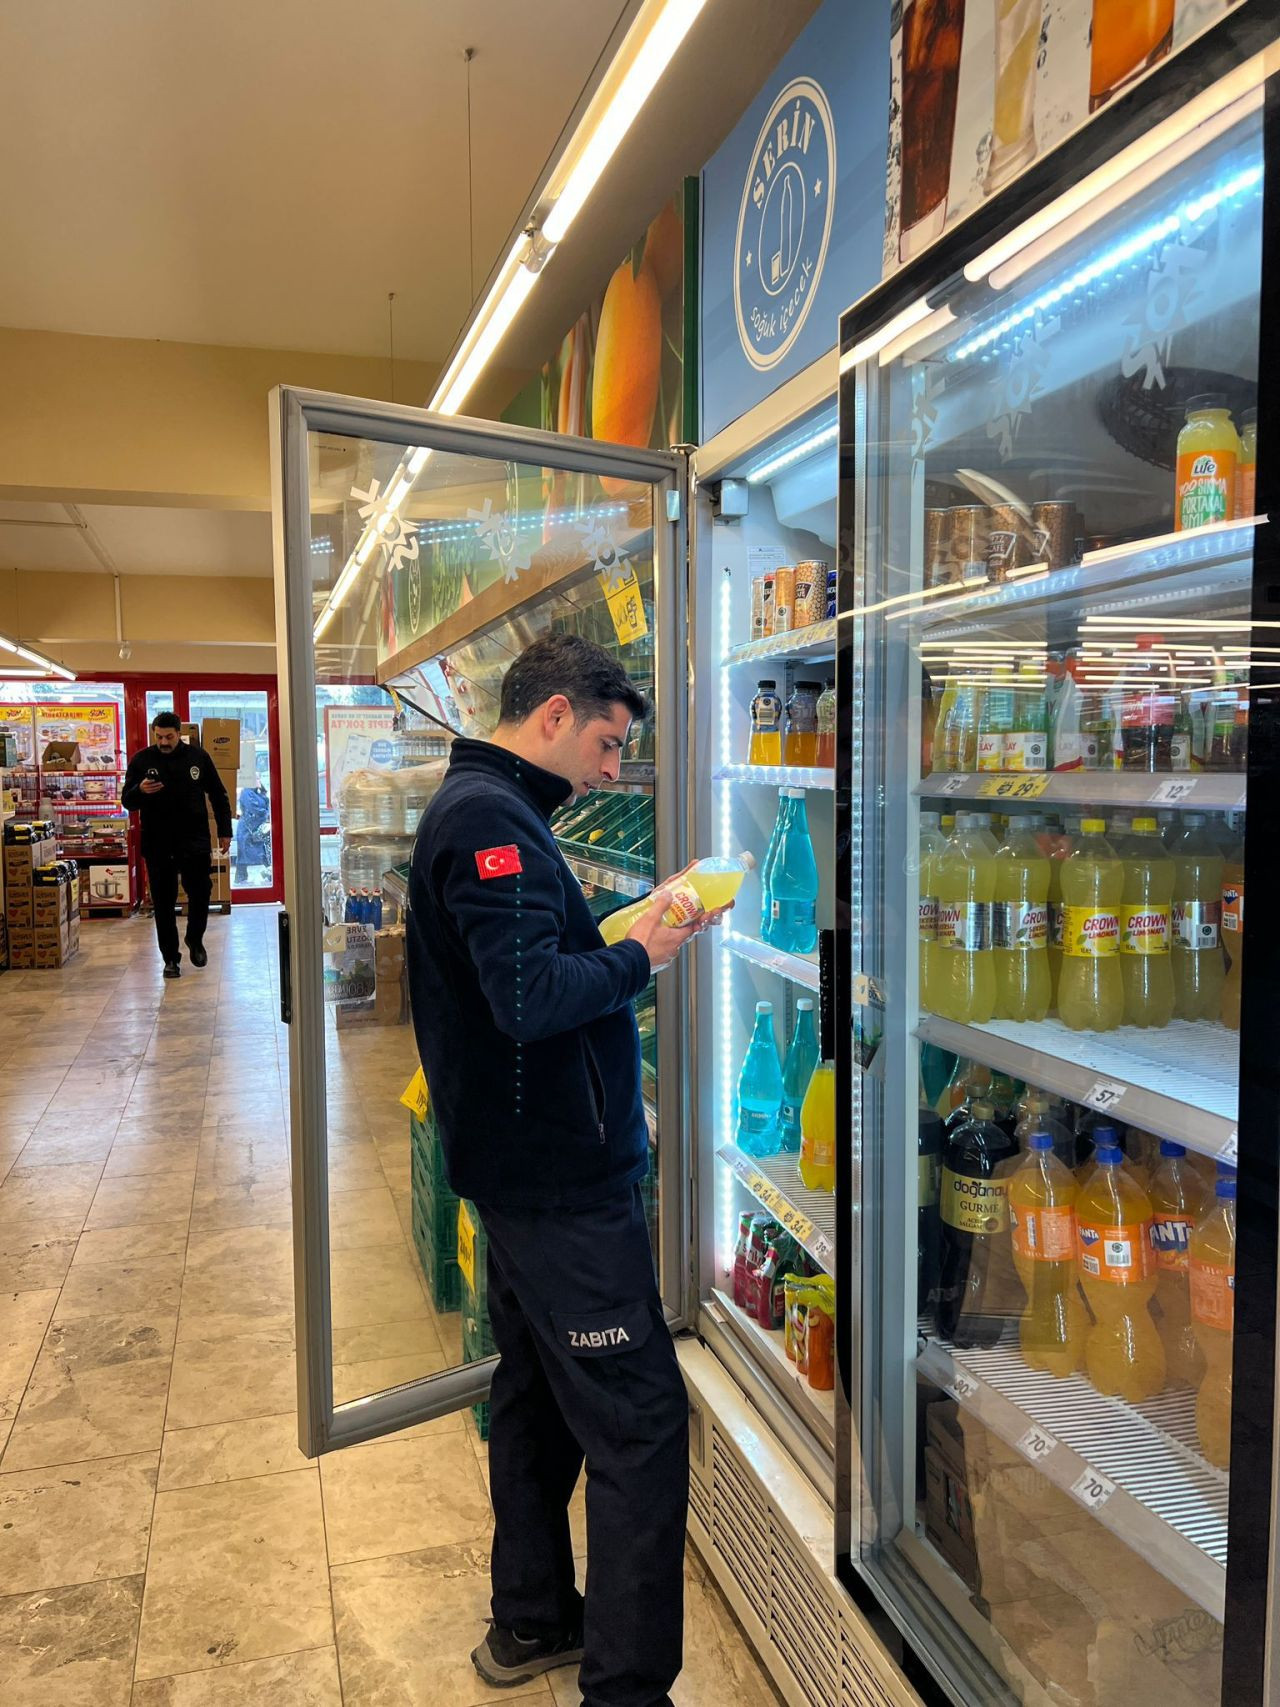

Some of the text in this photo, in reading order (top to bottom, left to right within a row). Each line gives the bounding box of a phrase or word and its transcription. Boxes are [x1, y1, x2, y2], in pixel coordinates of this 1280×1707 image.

[753, 99, 815, 210] SERİN
[780, 256, 812, 334] içecek
[1194, 460, 1215, 474] Life
[1012, 783, 1034, 796] 29
[1165, 785, 1184, 798] 12
[1083, 916, 1119, 931] CROWN
[1127, 914, 1168, 928] CROWN
[1096, 1090, 1115, 1104] 57
[790, 1220, 804, 1233] 34
[568, 1327, 630, 1347] ZABITA
[953, 1379, 969, 1395] 80
[1028, 1434, 1046, 1452] 70
[1083, 1478, 1103, 1499] 70
